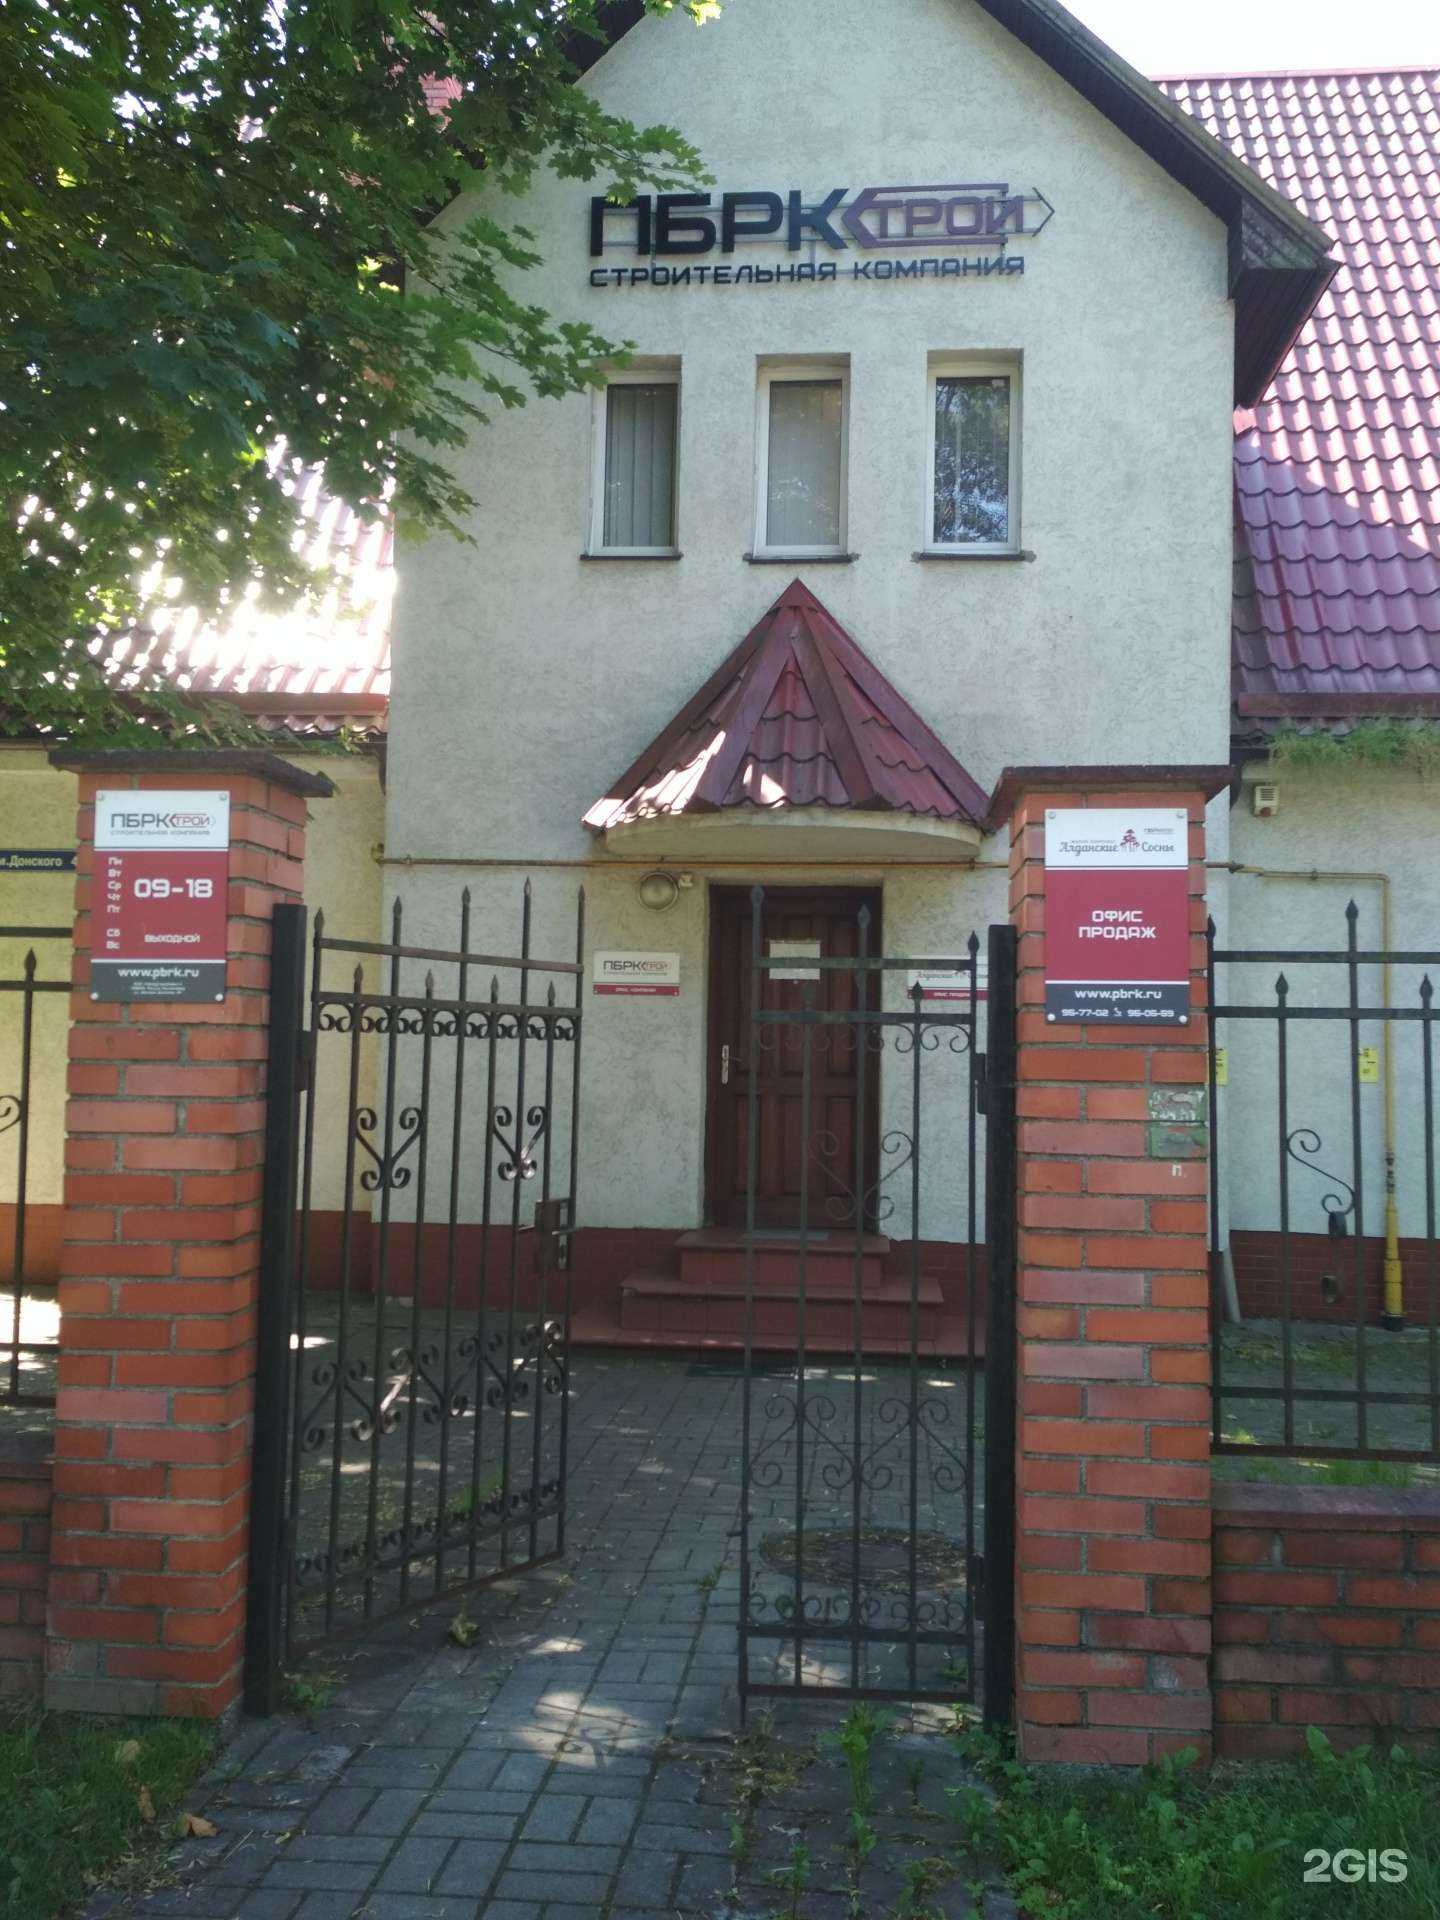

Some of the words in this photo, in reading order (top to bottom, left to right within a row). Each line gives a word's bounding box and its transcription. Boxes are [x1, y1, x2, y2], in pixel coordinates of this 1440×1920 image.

[590, 262, 837, 287] СТРОИТЕЛЬНАЯ
[853, 256, 1024, 281] КОМПАНИЯ
[108, 868, 122, 878] Вт
[107, 881, 121, 891] Ср
[134, 878, 213, 898] 09-18
[1092, 910, 1143, 922] ОФИС
[1078, 926, 1156, 940] ПРОДАЖ
[117, 967, 200, 980] www.pbrk.ru
[1074, 988, 1162, 1002] www.pbrk.ru
